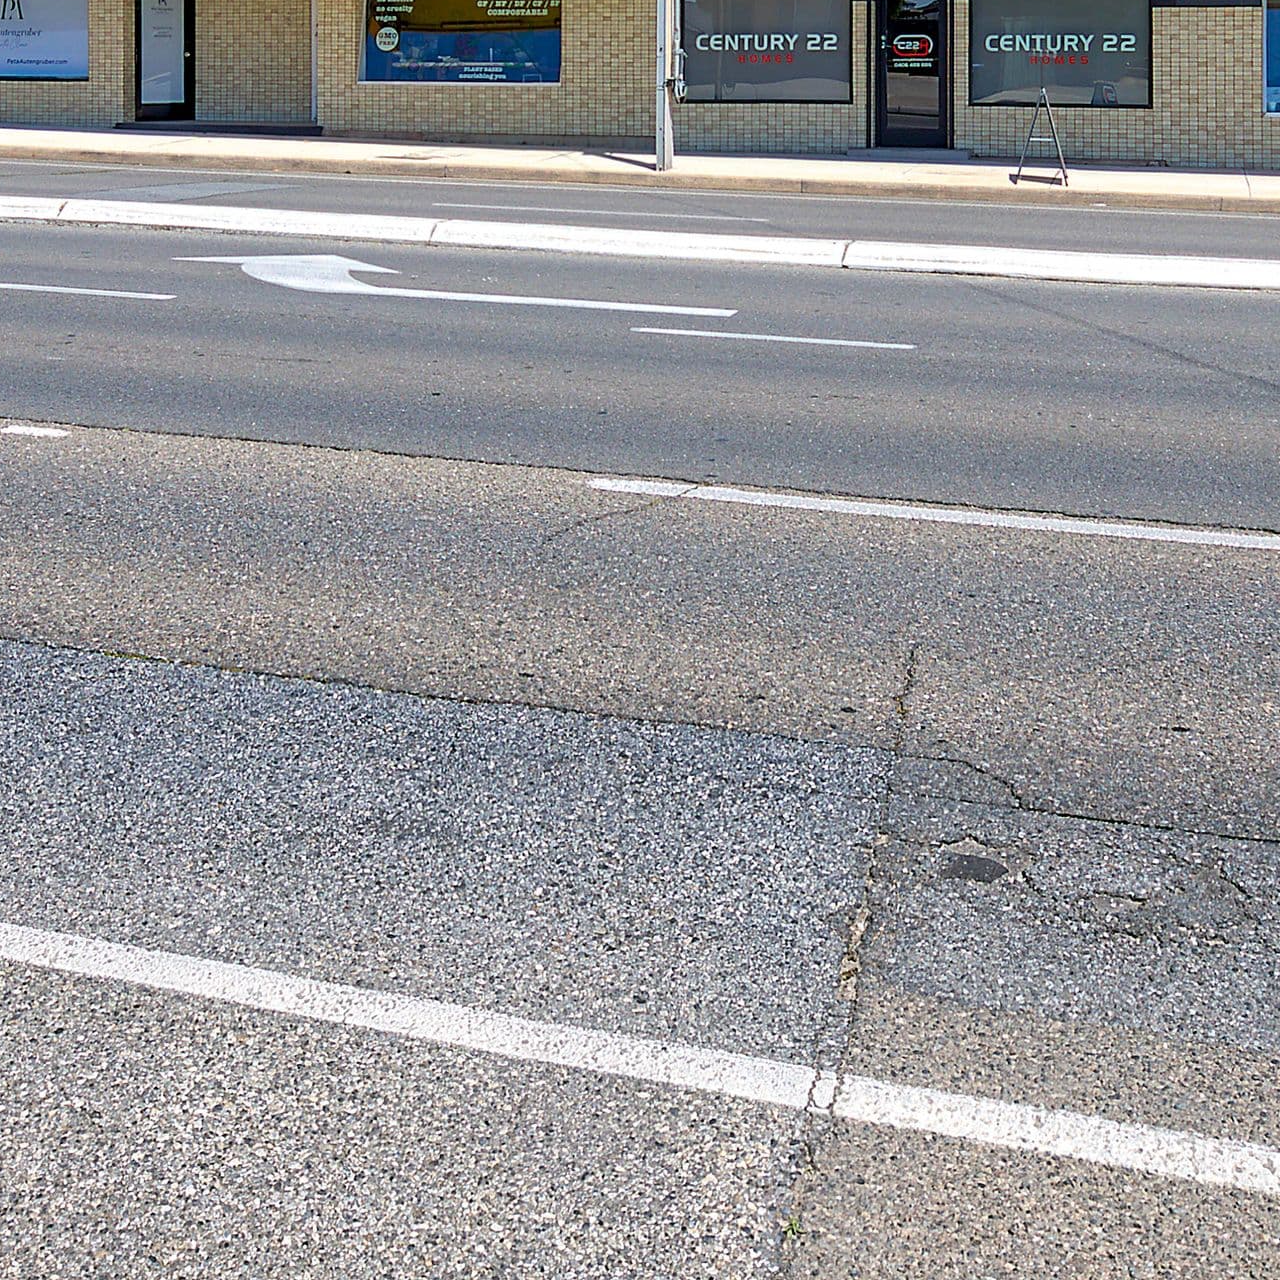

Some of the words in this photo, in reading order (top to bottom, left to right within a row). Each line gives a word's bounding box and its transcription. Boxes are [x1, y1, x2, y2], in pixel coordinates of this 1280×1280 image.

[387, 5, 413, 13] cruelty
[696, 34, 798, 51] CENTURY
[806, 34, 837, 50] 22
[985, 35, 1094, 52] CENTURY
[1102, 35, 1136, 51] 22
[738, 54, 794, 64] HOMES
[1029, 55, 1089, 64] HOMES
